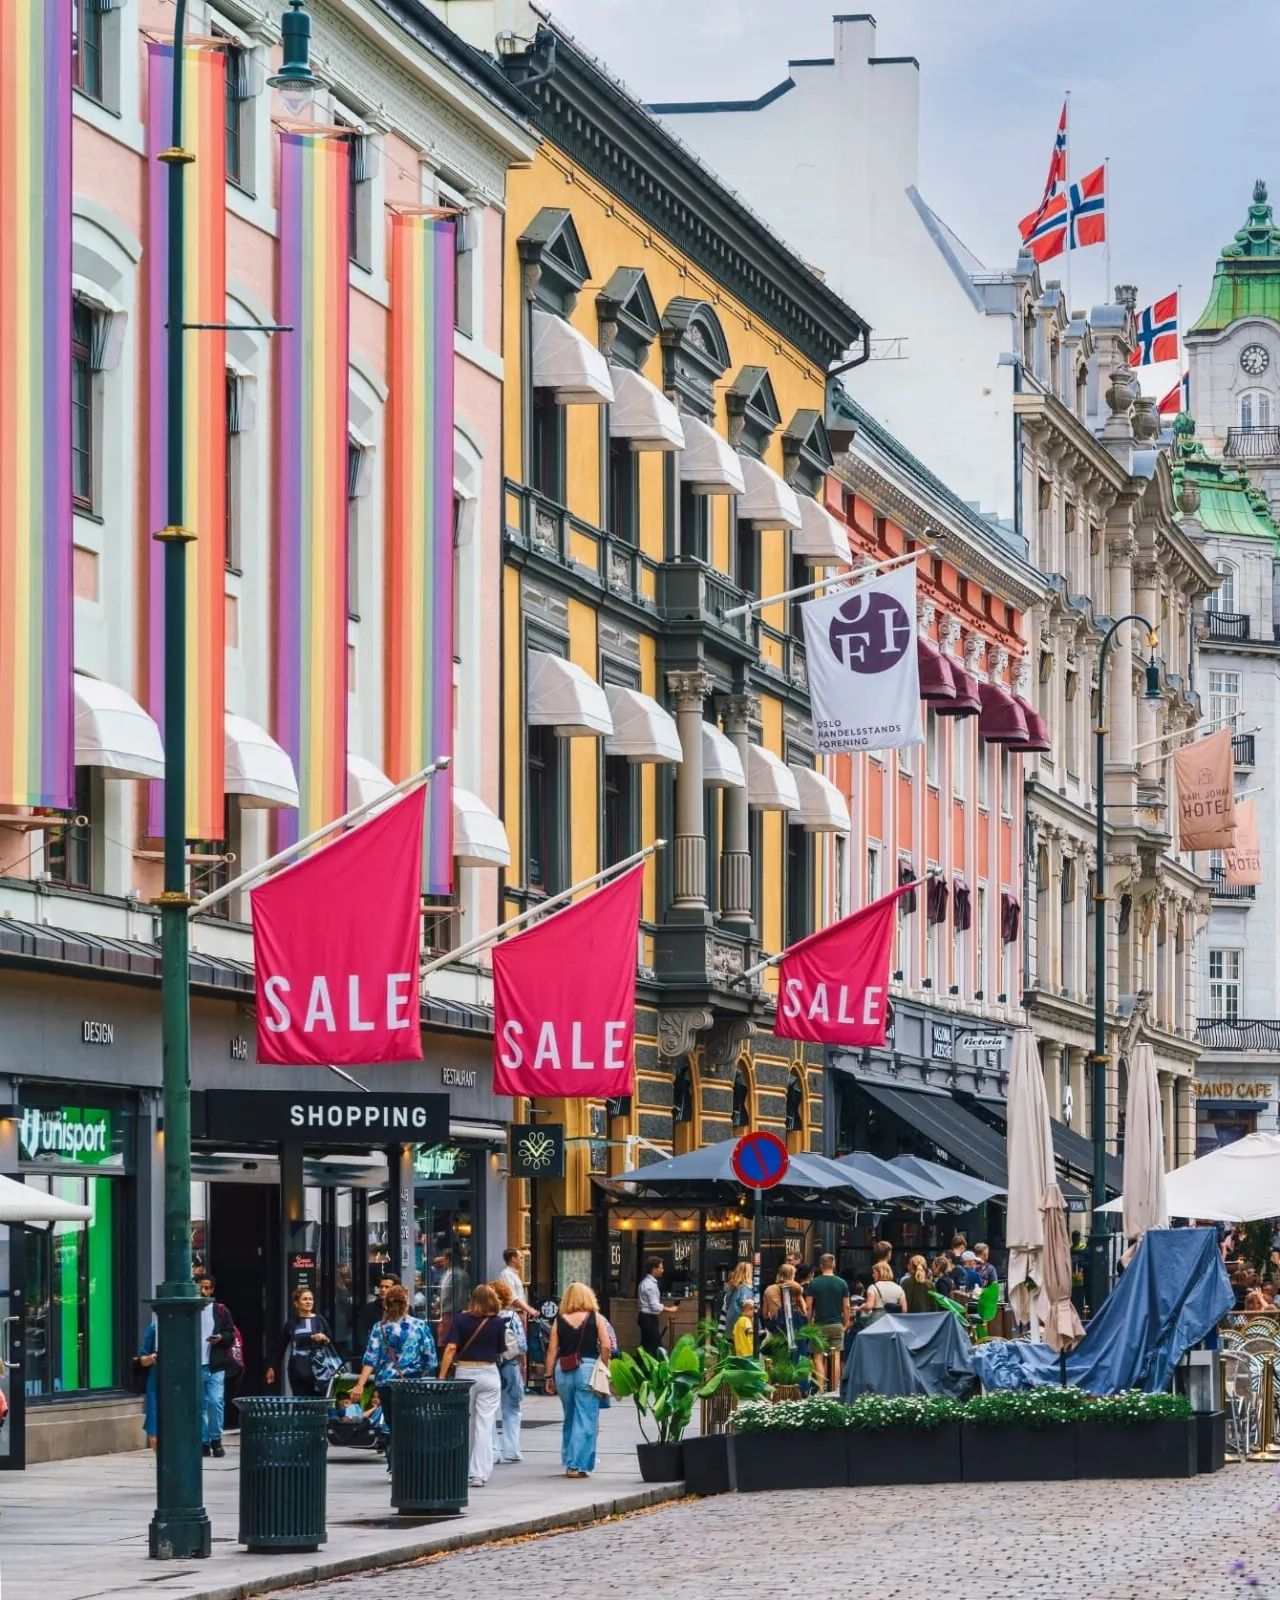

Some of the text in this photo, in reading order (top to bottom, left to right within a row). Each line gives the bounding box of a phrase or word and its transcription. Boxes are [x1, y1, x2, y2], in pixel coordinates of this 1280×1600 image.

[819, 738, 869, 748] FORENING
[1183, 797, 1231, 819] HOTEL
[1228, 858, 1262, 871] HOTEL
[264, 973, 412, 1033] SALE
[782, 979, 883, 1025] SALE
[84, 1021, 114, 1044] DESIGN
[963, 1037, 1003, 1046] Victoria
[232, 1035, 248, 1060] HÅR
[501, 1020, 627, 1070] SALE
[442, 1067, 477, 1088] RESTAURANT
[1194, 1082, 1235, 1098] RAND
[290, 1104, 428, 1128] SHOPPING
